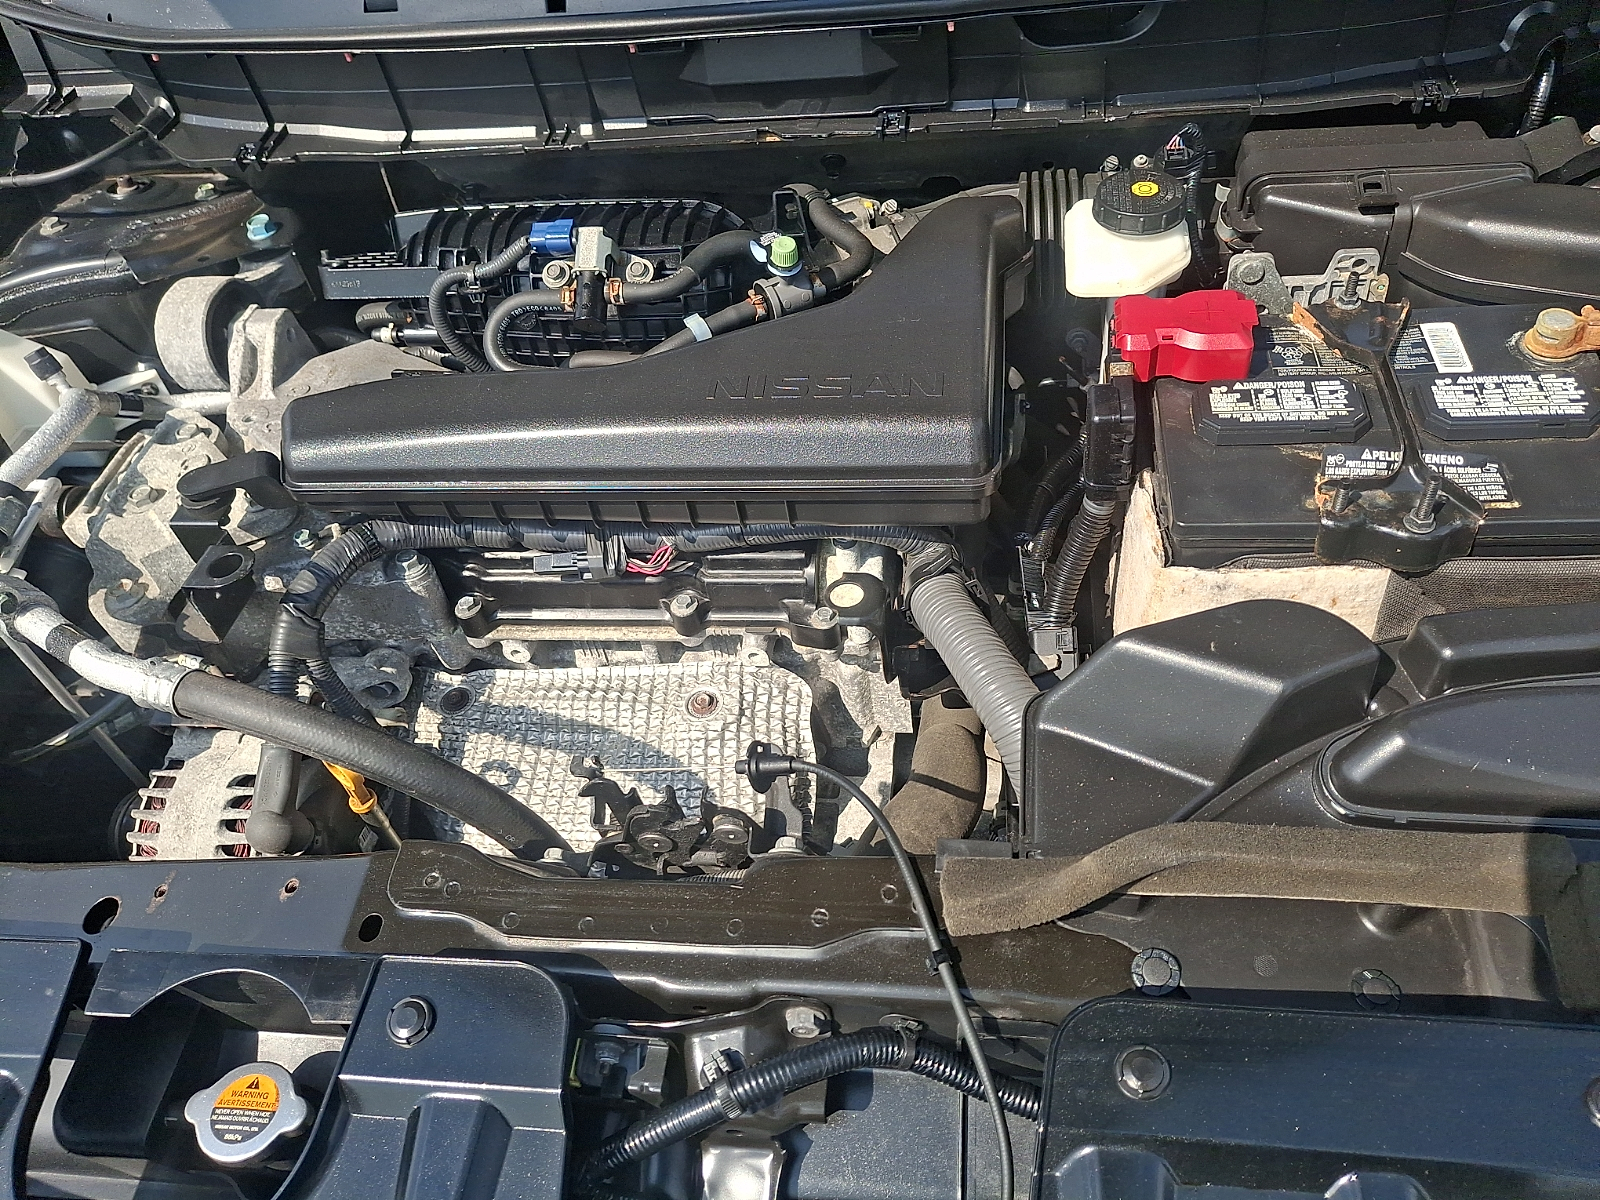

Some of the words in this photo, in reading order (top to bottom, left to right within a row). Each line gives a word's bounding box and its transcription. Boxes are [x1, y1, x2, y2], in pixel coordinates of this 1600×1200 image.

[1466, 375, 1532, 384] DANGER/POISON
[705, 374, 945, 401] NISSAN
[1243, 381, 1305, 389] DANGER/POISON
[1422, 453, 1464, 466] ENENO
[231, 1090, 270, 1100] WARNING
[217, 1098, 277, 1109] AVERTISSEMENT
